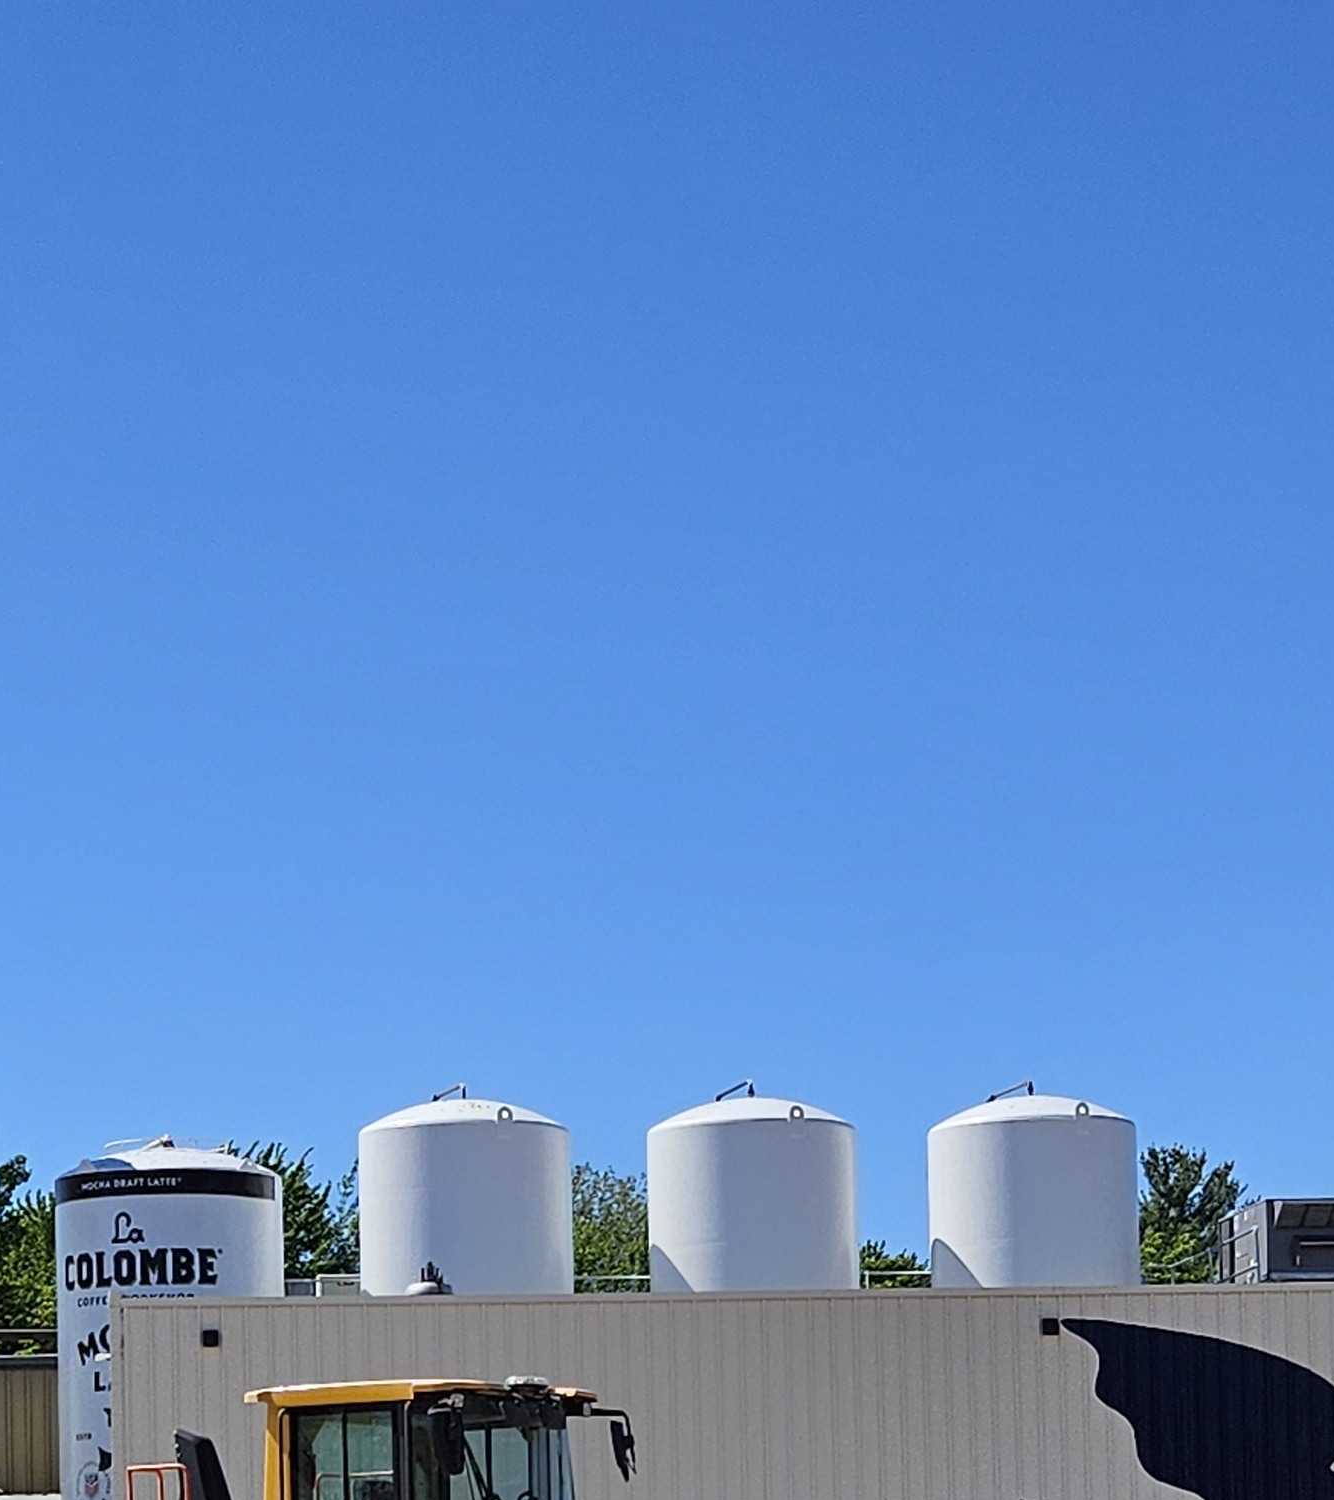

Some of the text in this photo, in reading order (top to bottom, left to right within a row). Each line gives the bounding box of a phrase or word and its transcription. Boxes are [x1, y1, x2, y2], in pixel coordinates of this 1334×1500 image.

[81, 1179, 111, 1191] MOCHA
[114, 1178, 144, 1188] DRAFT
[111, 1211, 145, 1244] La
[65, 1247, 219, 1291] COLOMBE
